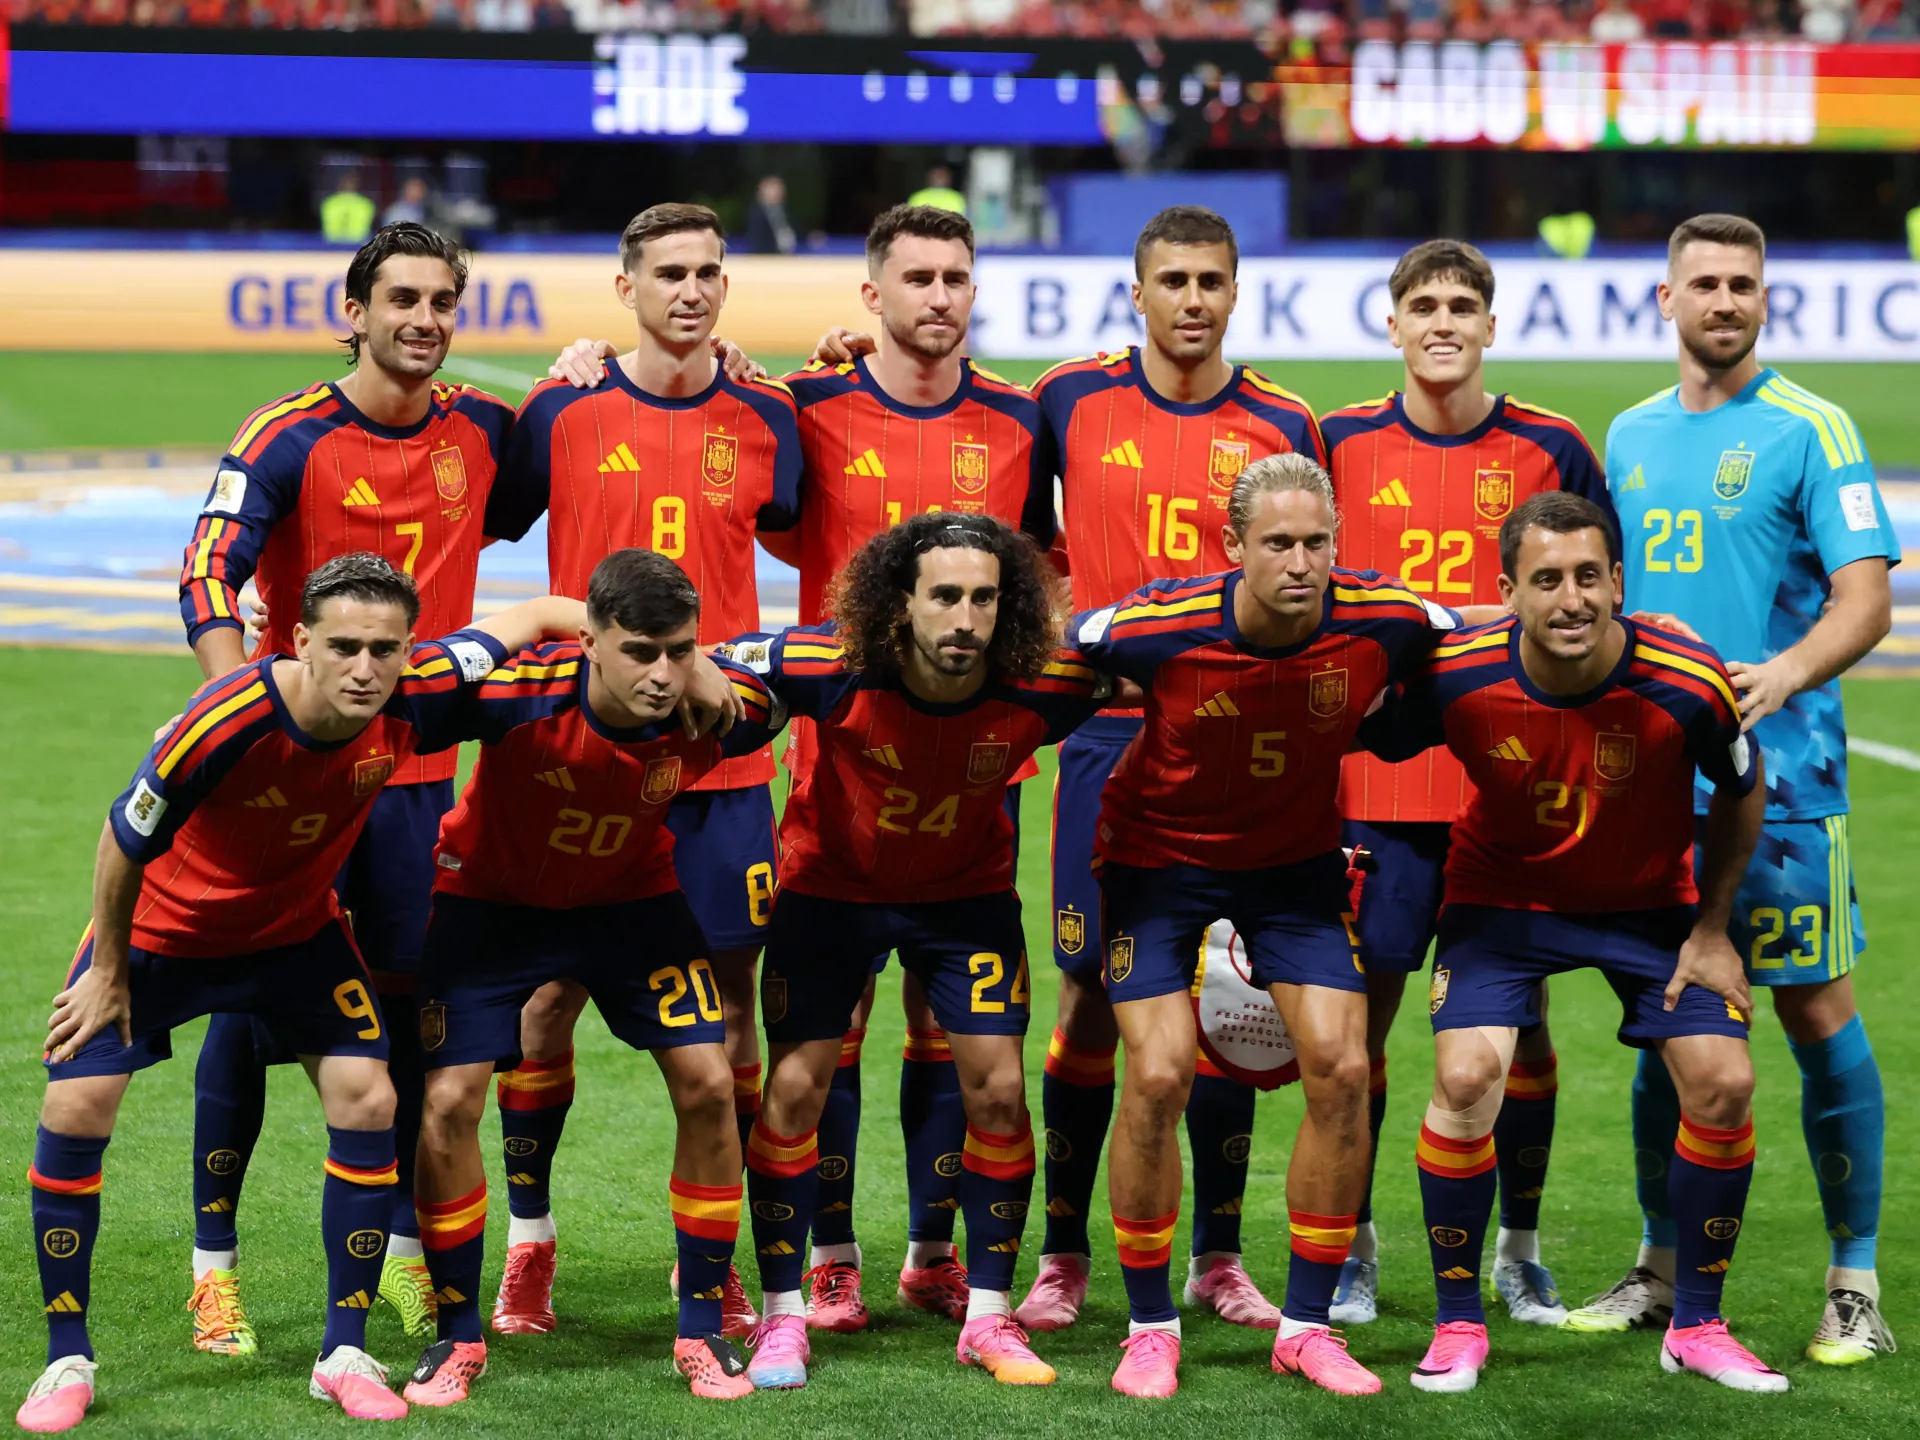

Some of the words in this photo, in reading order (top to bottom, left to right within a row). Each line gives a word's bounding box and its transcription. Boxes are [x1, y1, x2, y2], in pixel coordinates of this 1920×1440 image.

[1352, 39, 1527, 142] CABO
[1617, 42, 1816, 145] SPAIN
[228, 275, 545, 332] GEOIA
[1024, 279, 1306, 340] BAK
[1517, 281, 1920, 342] AMRIC
[395, 521, 424, 575] 7
[652, 496, 686, 560] 8
[1146, 493, 1199, 561] 16
[1643, 508, 1703, 573] 23
[1399, 529, 1474, 594] 22
[1249, 730, 1287, 777] 5
[287, 813, 328, 846] 9
[548, 808, 632, 857] 20
[876, 786, 960, 838] 24
[1534, 781, 1588, 839] 21
[746, 861, 774, 926] 8
[1750, 904, 1822, 969] 23
[333, 979, 381, 1040] 9
[648, 958, 723, 1028] 20
[968, 952, 1030, 1013] 24
[1245, 1003, 1274, 1013] REAL
[1216, 1011, 1279, 1025] FEDERACI
[356, 1235, 377, 1243] RF
[356, 1243, 377, 1252] EF
